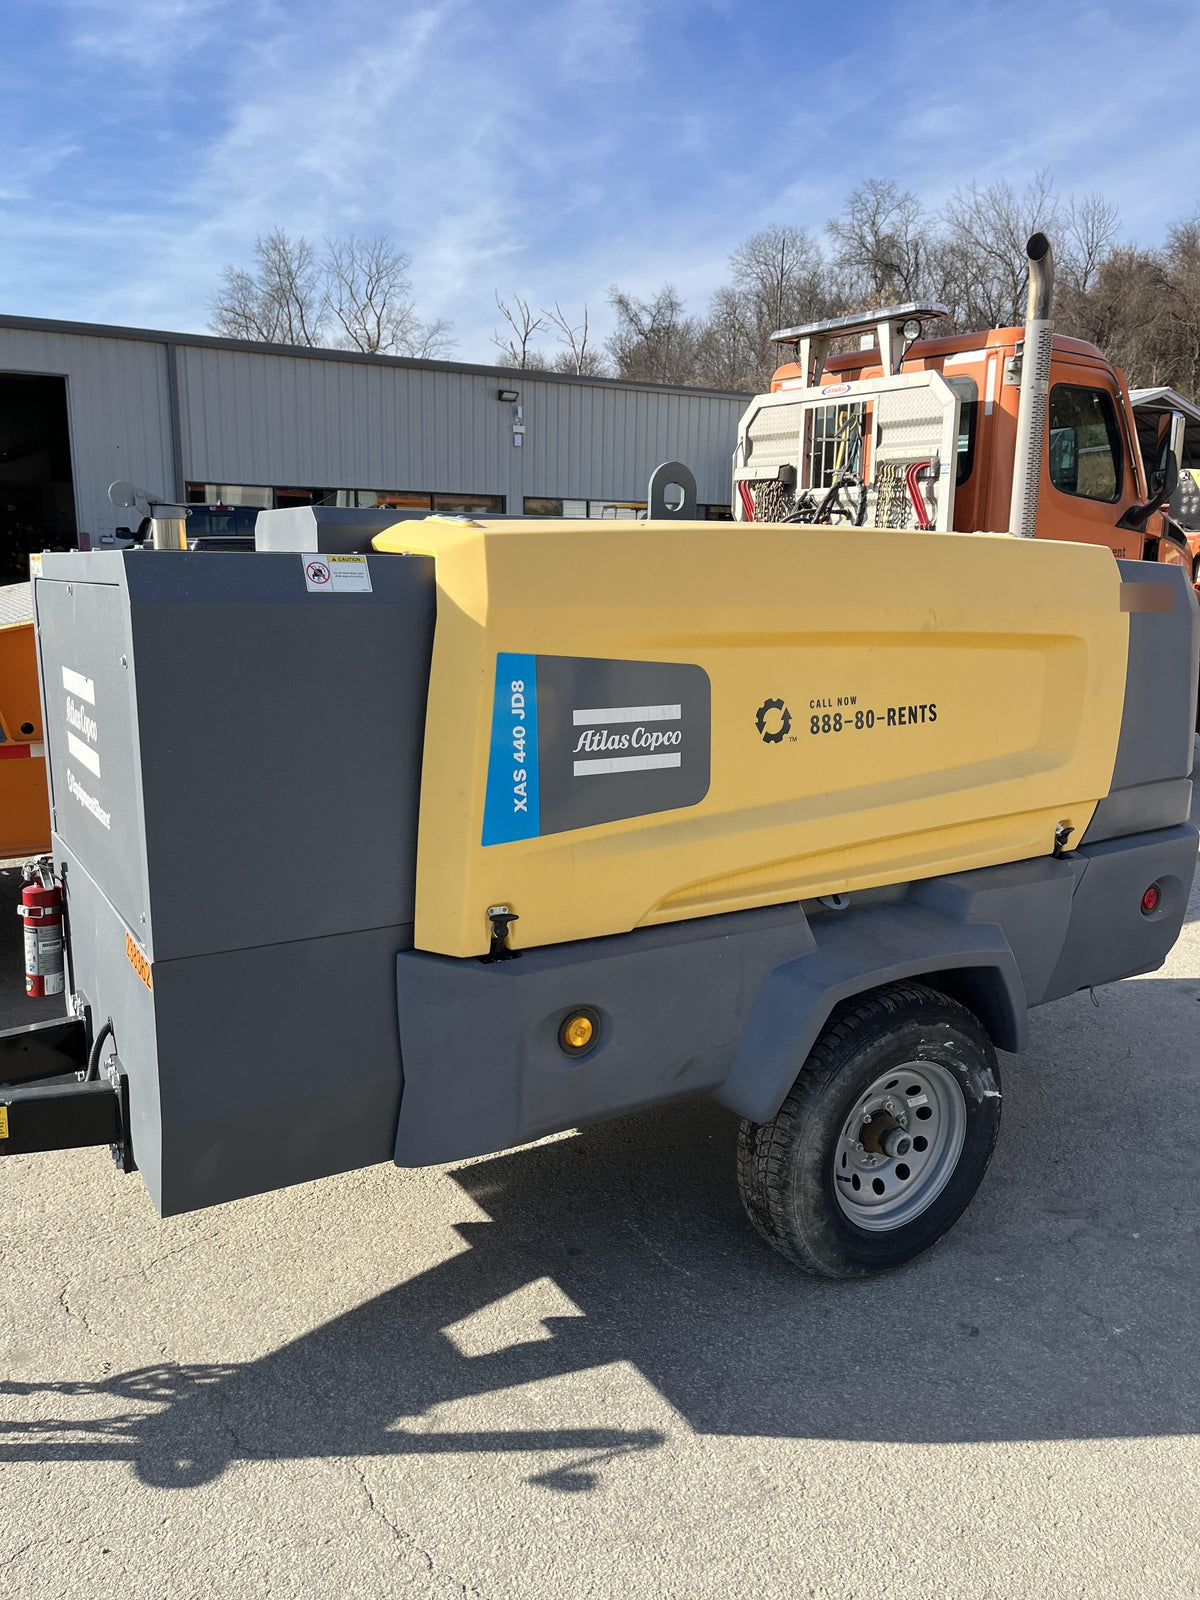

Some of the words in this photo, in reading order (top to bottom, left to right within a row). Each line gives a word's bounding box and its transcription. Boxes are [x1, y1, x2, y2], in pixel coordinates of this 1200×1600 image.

[511, 679, 526, 721] JD8
[809, 698, 833, 710] CALL
[837, 695, 857, 707] NOW
[809, 703, 938, 735] 888-80-RENTS
[512, 725, 526, 764] 440
[572, 730, 630, 753] Atlas
[631, 726, 682, 751] Copco
[512, 768, 528, 813] XAS
